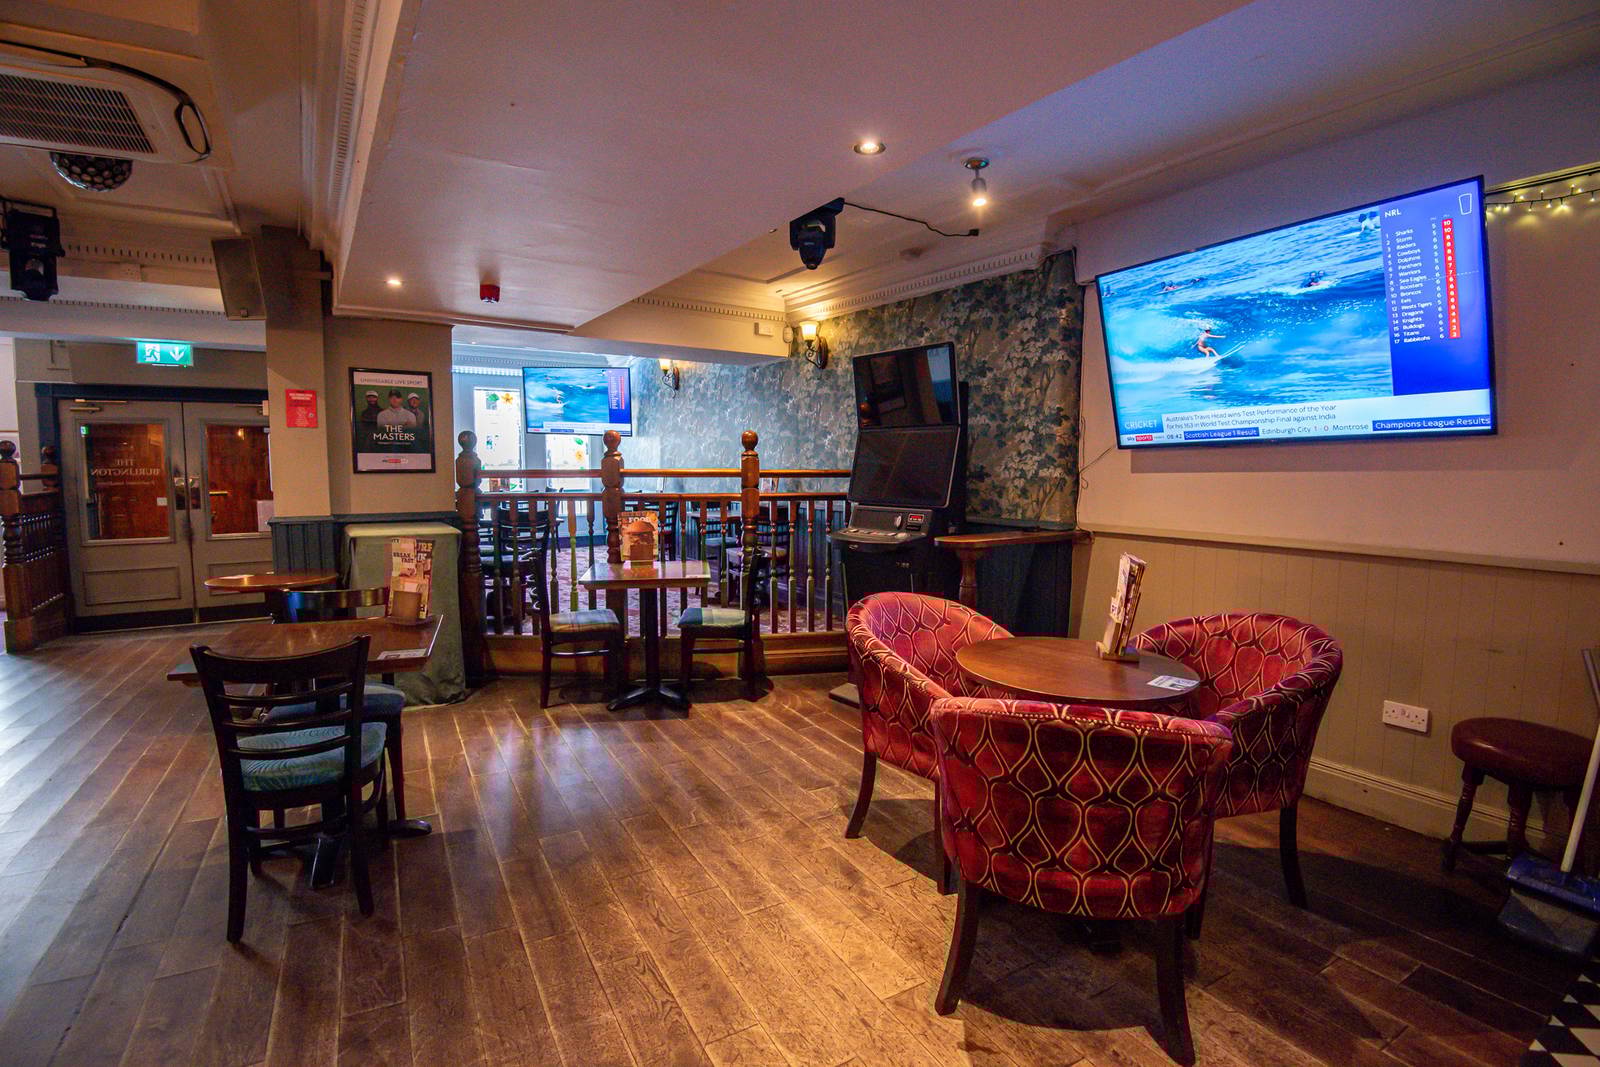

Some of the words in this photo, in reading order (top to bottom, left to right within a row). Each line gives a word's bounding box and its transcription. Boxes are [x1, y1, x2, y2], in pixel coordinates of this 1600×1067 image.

[1384, 208, 1402, 218] NRL
[1125, 420, 1157, 430] CRICKET
[1232, 417, 1275, 426] Championship
[1375, 421, 1420, 429] Champions
[1423, 420, 1455, 428] League
[1210, 430, 1231, 438] League
